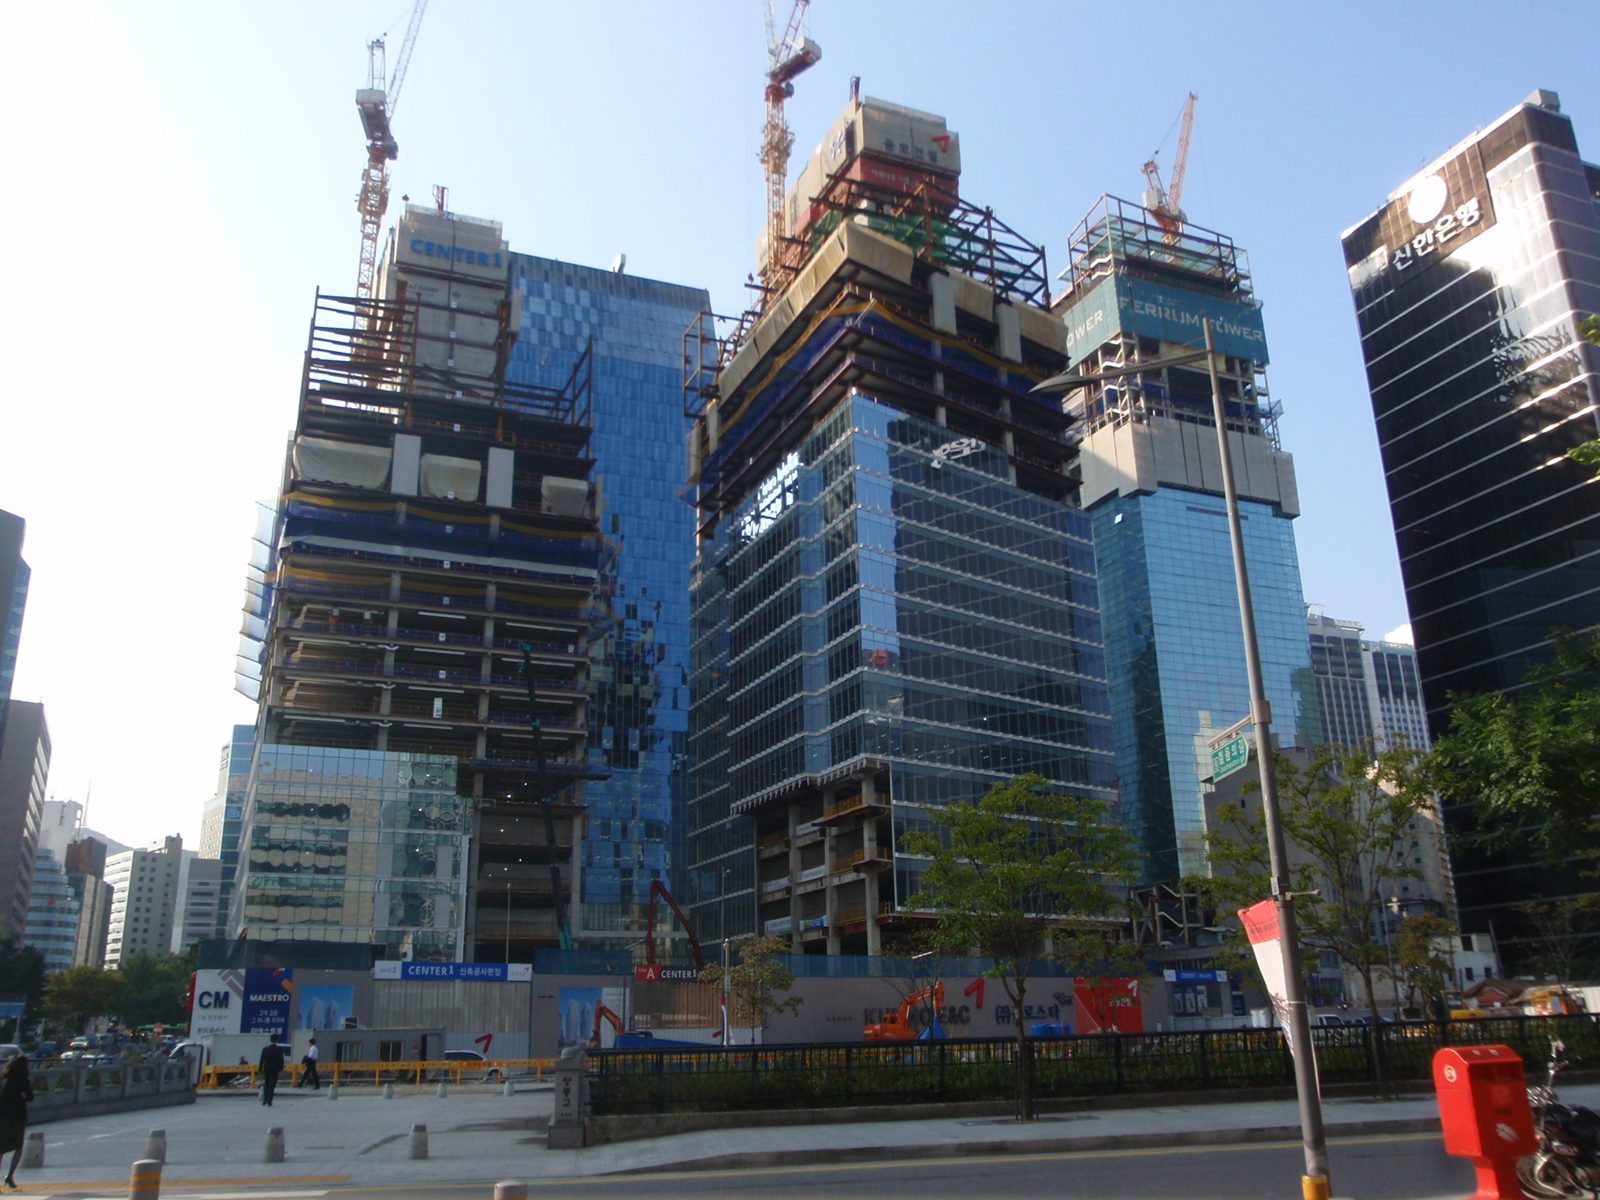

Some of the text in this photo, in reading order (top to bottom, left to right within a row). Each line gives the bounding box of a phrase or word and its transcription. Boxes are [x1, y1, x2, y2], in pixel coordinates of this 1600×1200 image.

[1392, 197, 1481, 271] 신한은행
[1066, 309, 1104, 346] OWER
[1119, 297, 1264, 343] FERRUM TOWER
[646, 967, 656, 980] A
[198, 991, 230, 1009] CM
[249, 994, 290, 1002] MAESTRO
